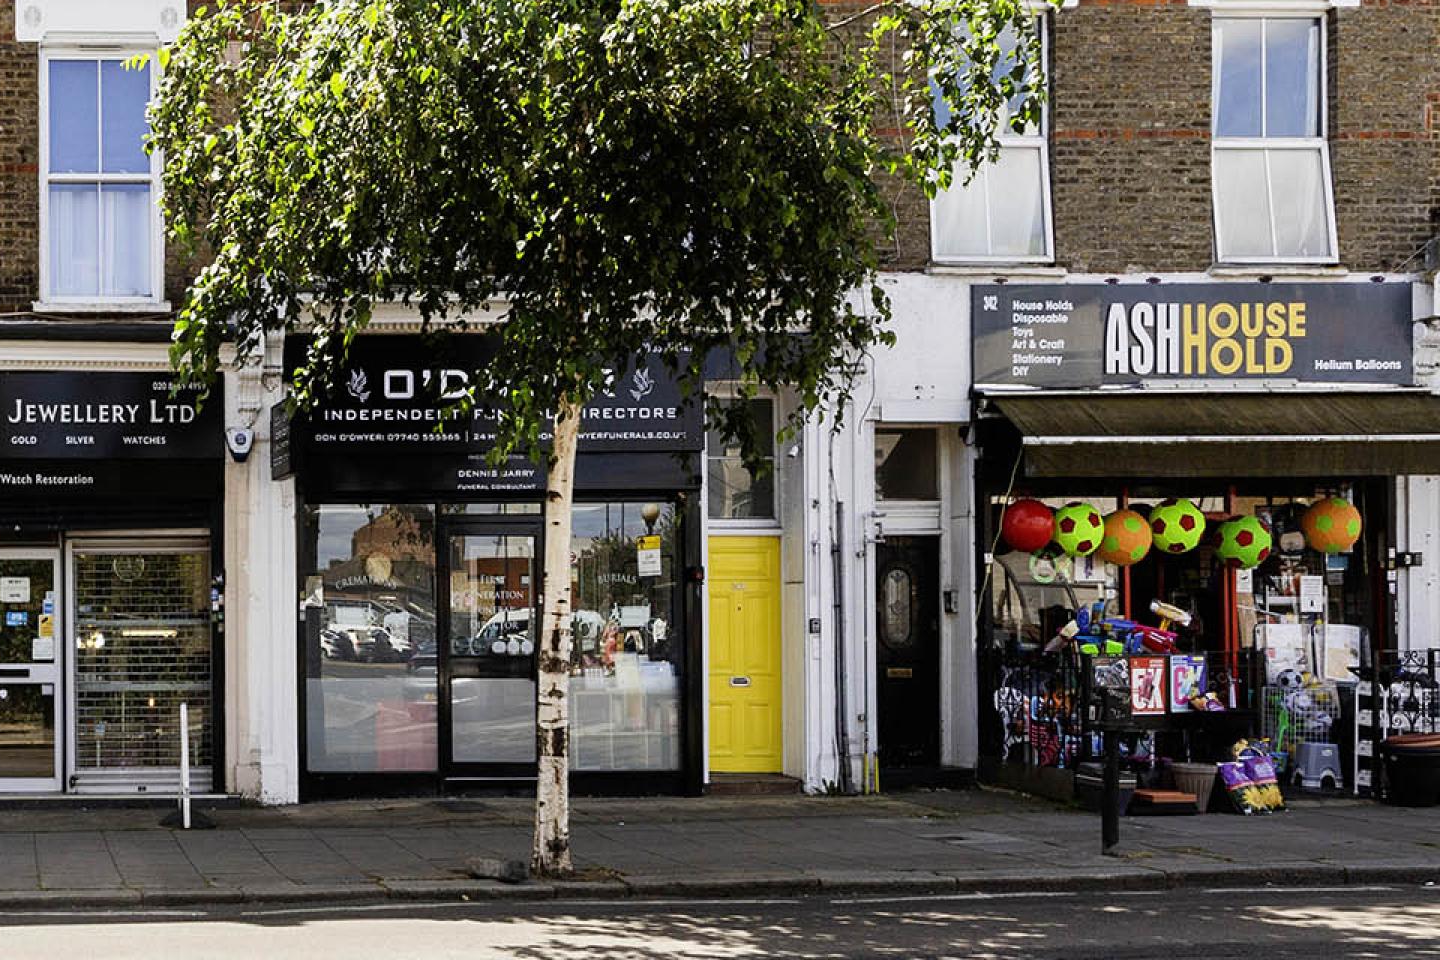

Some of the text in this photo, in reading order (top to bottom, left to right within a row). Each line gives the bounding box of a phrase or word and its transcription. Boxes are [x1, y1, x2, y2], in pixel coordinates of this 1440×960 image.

[1013, 300, 1043, 310] House
[1046, 300, 1074, 311] Holds
[1012, 313, 1068, 324] Disposable
[1012, 326, 1033, 338] Toys
[1106, 302, 1180, 375] ASH
[1012, 339, 1065, 350] Art & Craft
[1012, 353, 1063, 366] Stationery
[1315, 359, 1402, 370] Helium Balloons
[1012, 366, 1029, 376] DIY
[8, 399, 139, 423] JEWELLERY
[582, 407, 677, 419] IRECTORS
[12, 436, 37, 445] GOLD
[66, 436, 95, 445] SILVER
[123, 436, 166, 445] WATCHES
[0, 473, 32, 485] Watch
[36, 473, 94, 485] Restoration
